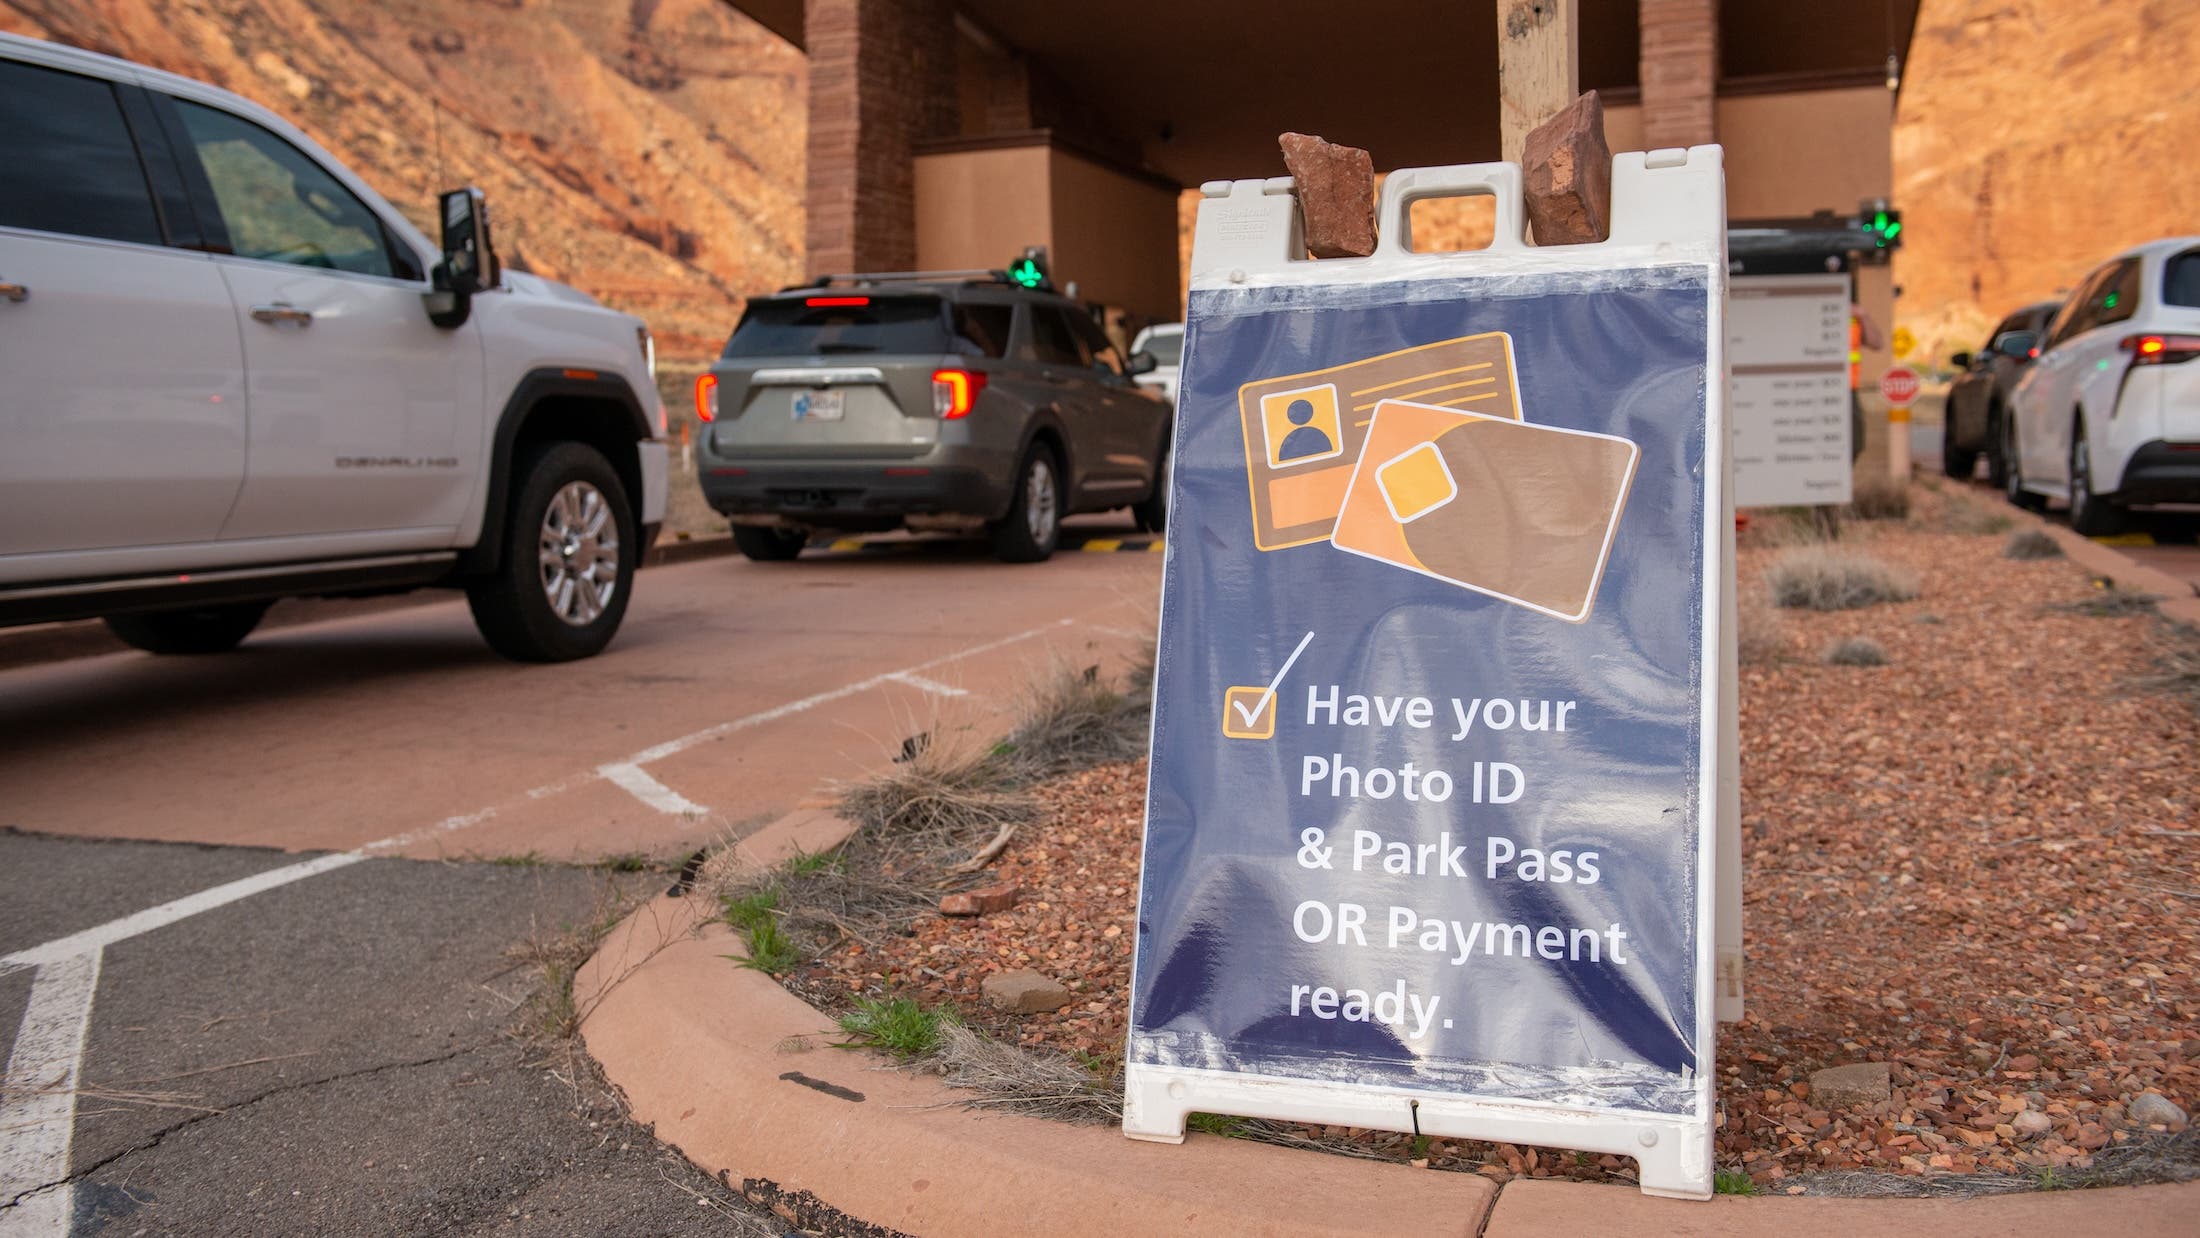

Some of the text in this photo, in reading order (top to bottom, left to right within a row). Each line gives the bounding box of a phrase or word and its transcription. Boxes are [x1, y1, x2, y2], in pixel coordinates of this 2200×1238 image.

[1884, 377, 1916, 393] STOP
[1306, 685, 1576, 741] Have your
[1301, 753, 1525, 804] Photo ID
[1296, 827, 1600, 885] & Park Pass
[1293, 900, 1628, 965] OR Payment
[1291, 979, 1454, 1039] ready.
